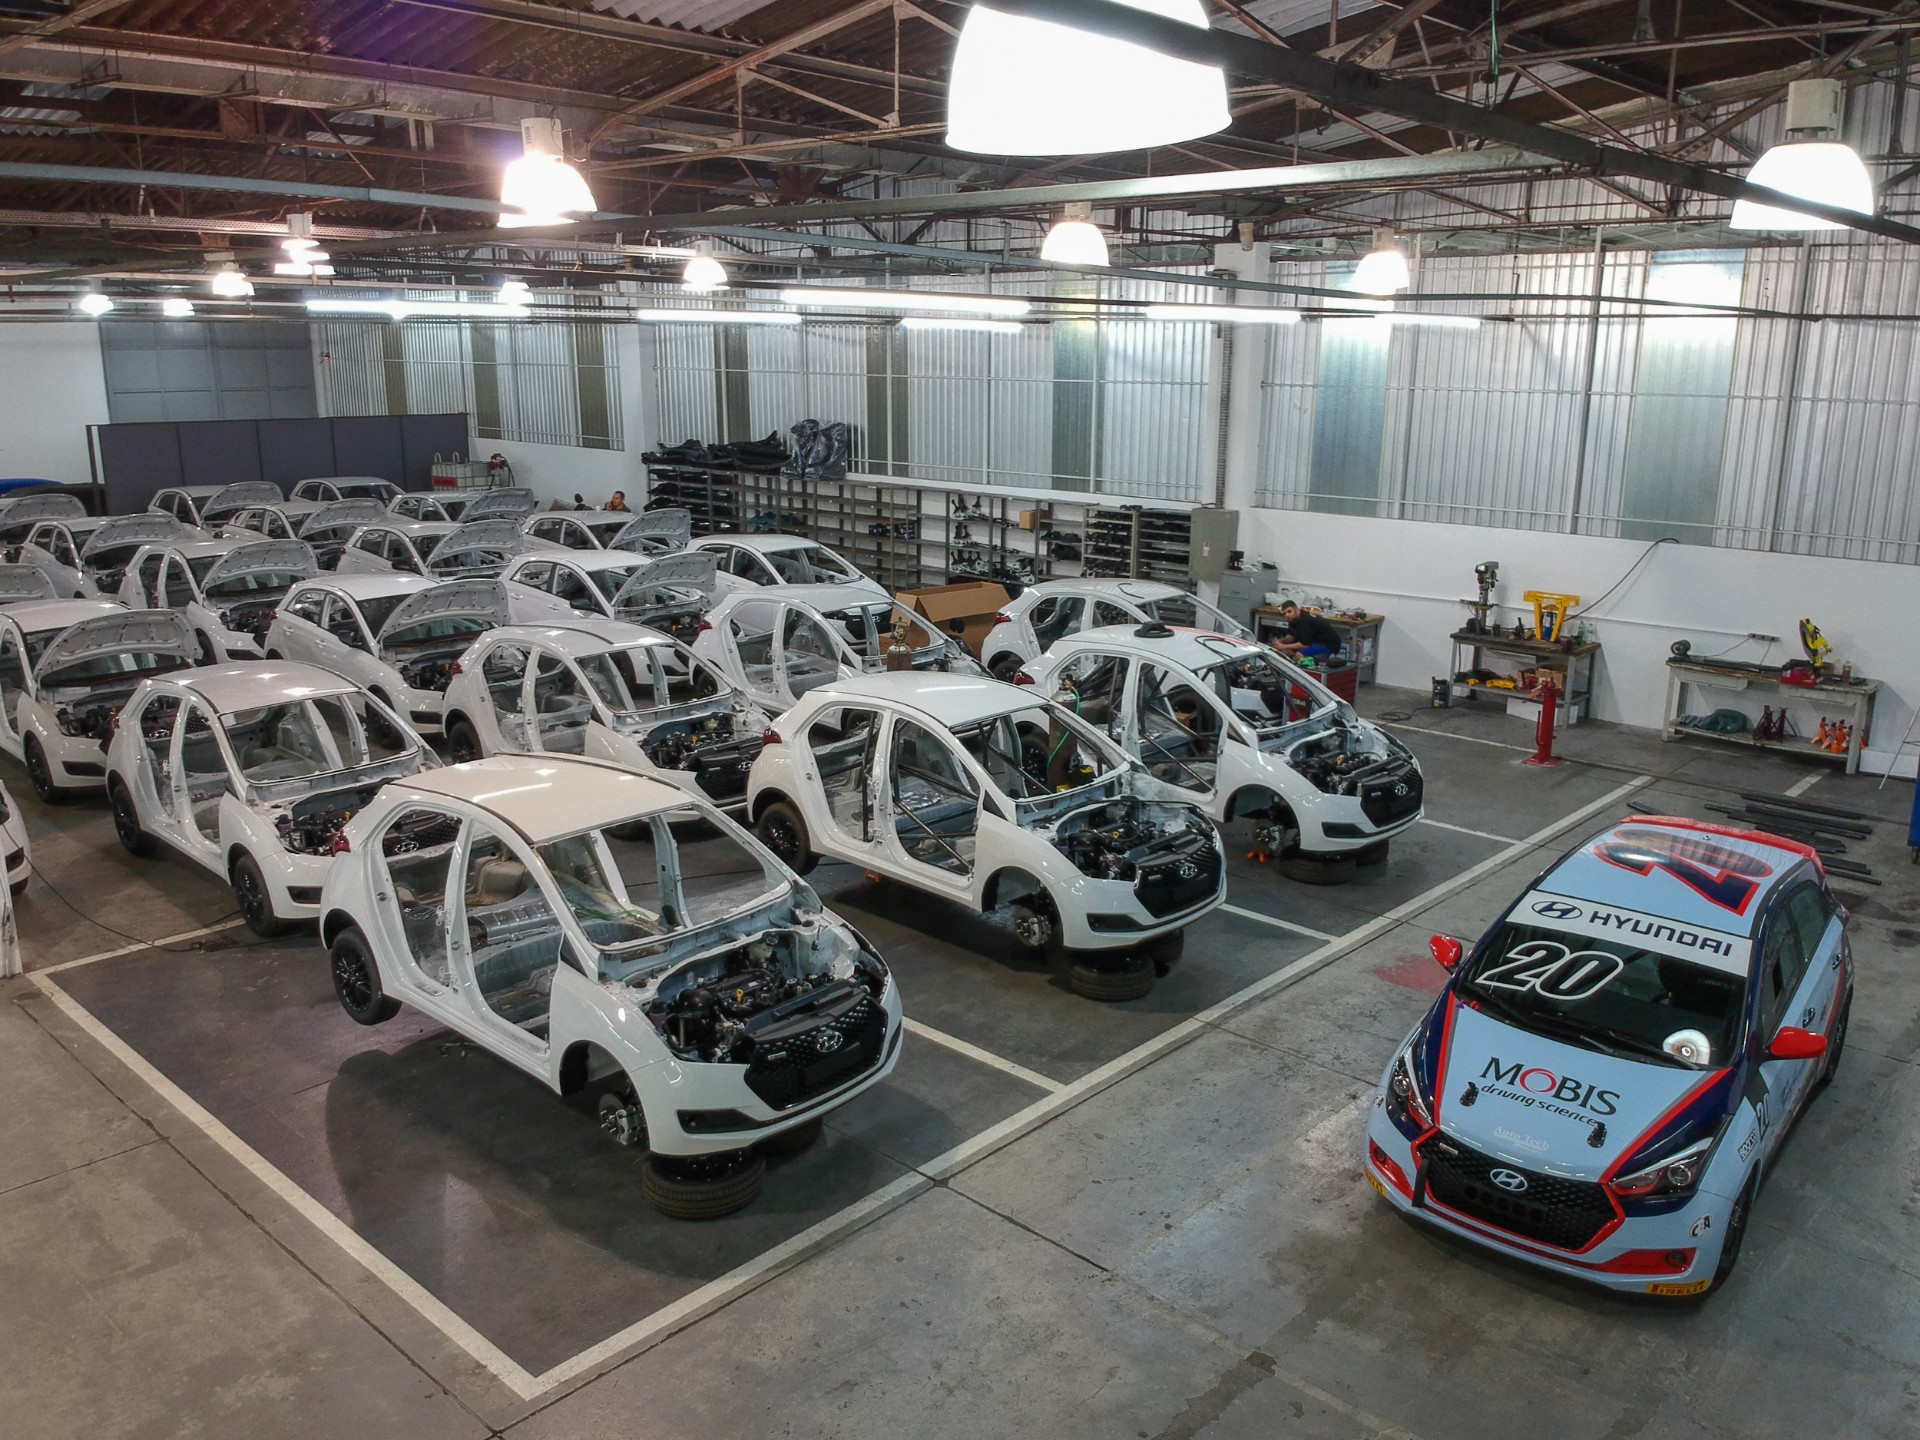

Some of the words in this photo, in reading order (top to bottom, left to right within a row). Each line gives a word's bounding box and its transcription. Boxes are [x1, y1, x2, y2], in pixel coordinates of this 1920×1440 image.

[1588, 909, 1733, 957] HYUNDAI
[1475, 940, 1625, 1000] 20
[1479, 1056, 1621, 1116] MOBIS
[1481, 1083, 1536, 1107] driving
